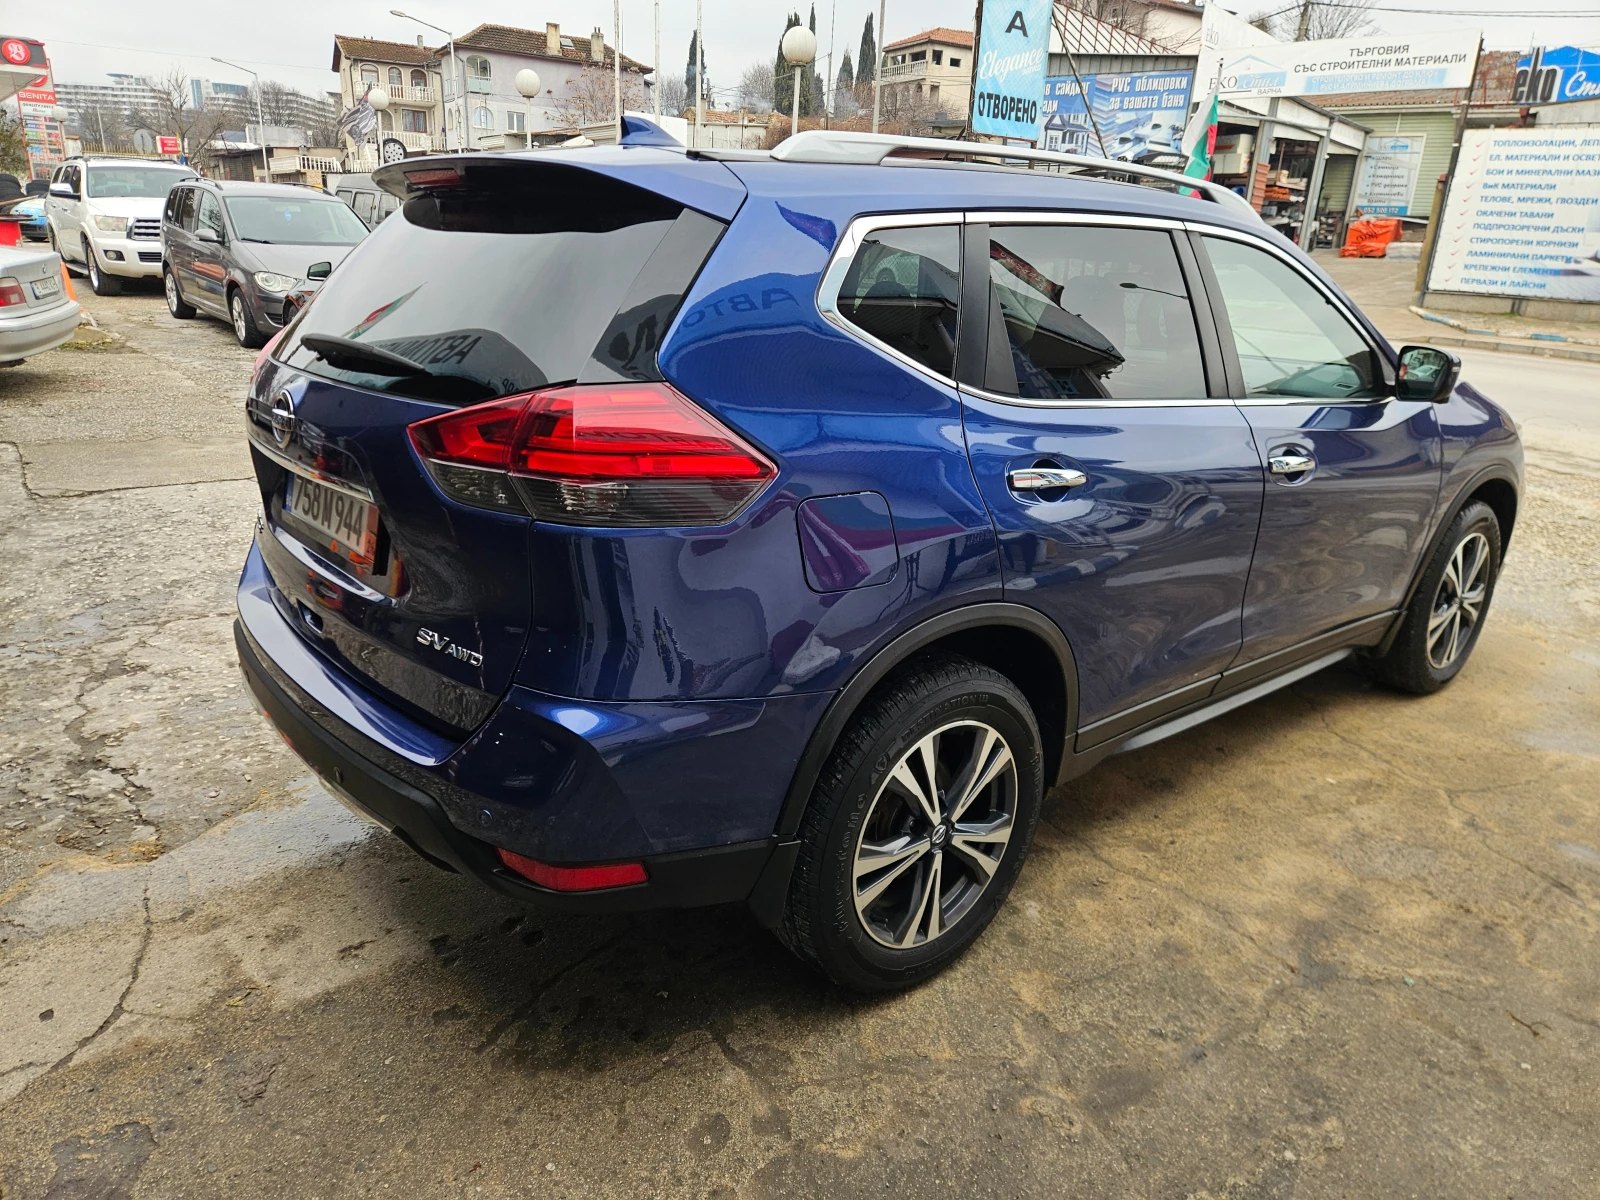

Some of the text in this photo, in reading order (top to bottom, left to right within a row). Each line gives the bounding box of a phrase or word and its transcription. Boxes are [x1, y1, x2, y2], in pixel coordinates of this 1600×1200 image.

[1349, 44, 1410, 58] ТЪРГОВИЯ
[979, 47, 1044, 84] Elegance
[1294, 53, 1467, 73] СЪС СТРОИТЕЛНИ МАТЕРИАЛИ
[1111, 75, 1188, 93] PVC облицовки
[18, 91, 54, 101] BENITA
[1257, 87, 1282, 95] ВАРНА
[1109, 92, 1185, 110] за вашата баня
[978, 91, 1037, 125] ОТВОРЕНО
[1493, 139, 1577, 148] ТОПЛОИЗОЛАЦИИ,
[1505, 154, 1560, 162] МАТЕРИАЛИ
[1486, 168, 1504, 176] БОИ
[1515, 169, 1573, 177] МИНЕРАЛНИ
[1482, 182, 1557, 191] ВиК МАТЕРИАЛИ
[1480, 195, 1599, 206] ТЕЛОВЕ, МРЕЖИ, ГВОЗДЕИ
[1476, 210, 1555, 219] ОКАЧЕНИ ТАВАНИ
[1473, 223, 1585, 234] ПОДПРОЗОРЕЧНИ ДЪСКИ
[1470, 237, 1579, 248] СТИРОПОРЕНИ КОРНИЗИ
[1467, 250, 1529, 259] ЛАМИНИРАНИ
[1463, 263, 1561, 276] КРЕПЕЖНИ ЕЛЕМЕНТИ
[1460, 277, 1498, 286] ПЕРВАЗИ
[1508, 279, 1547, 289] ЛАЙСНИ
[416, 627, 483, 667] SV AWD
